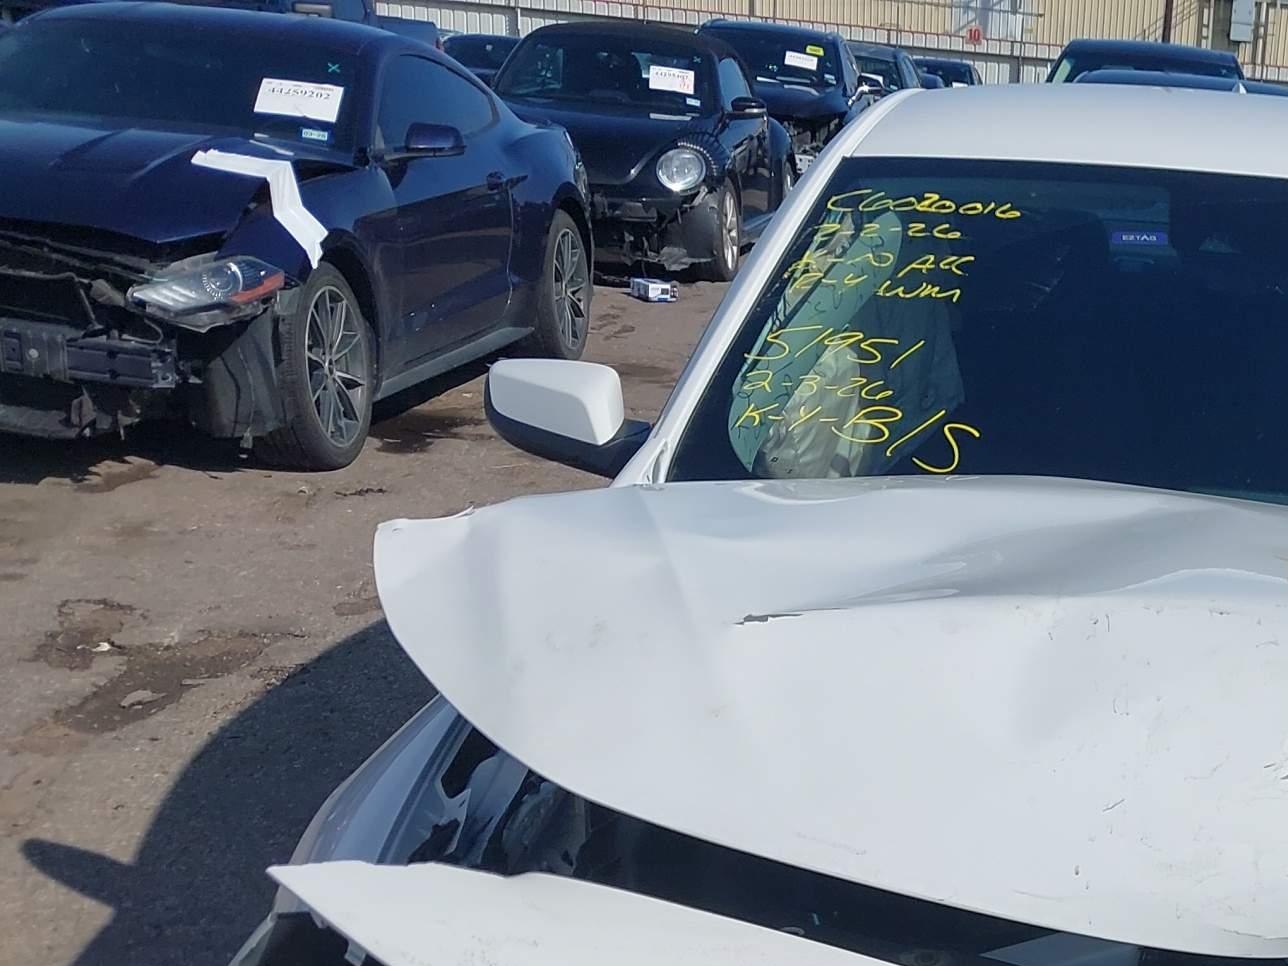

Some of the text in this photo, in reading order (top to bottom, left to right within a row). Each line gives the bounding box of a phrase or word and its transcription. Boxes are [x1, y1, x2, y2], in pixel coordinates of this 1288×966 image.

[968, 28, 980, 41] 10
[744, 325, 925, 368] 51951
[743, 370, 894, 400] 2-3-26
